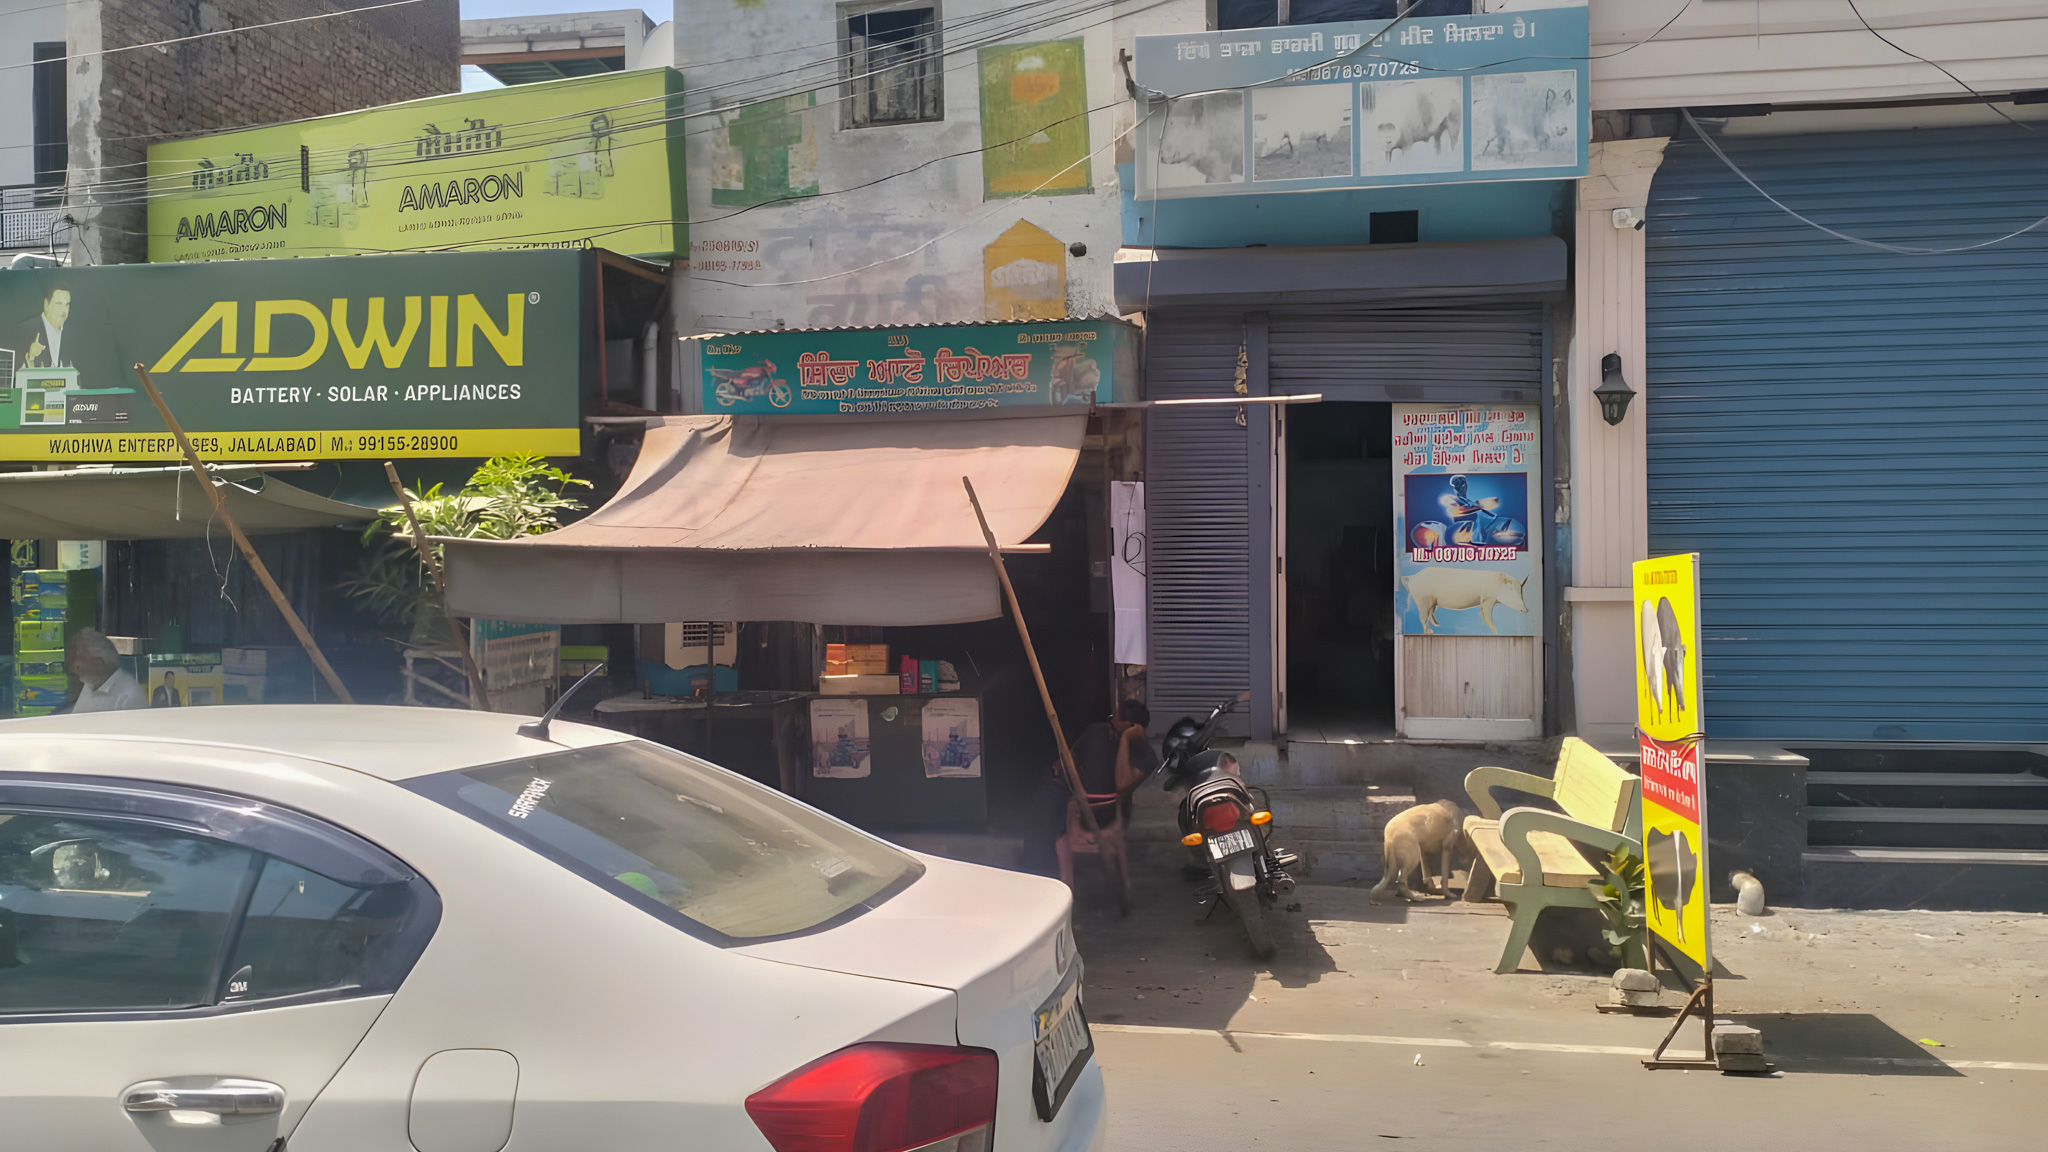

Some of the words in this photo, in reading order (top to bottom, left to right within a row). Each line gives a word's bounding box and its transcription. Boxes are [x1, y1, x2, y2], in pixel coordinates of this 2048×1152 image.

[399, 172, 523, 212] AMARON
[175, 202, 287, 243] AMARON
[149, 293, 525, 374] ADWIN
[231, 386, 312, 403] BATTERY
[327, 385, 388, 402] SOLAR
[404, 384, 521, 401] APPLIANCES
[49, 439, 113, 454] WADHWA
[228, 436, 316, 453] JALALABAD
[358, 436, 458, 451] 99155-28900
